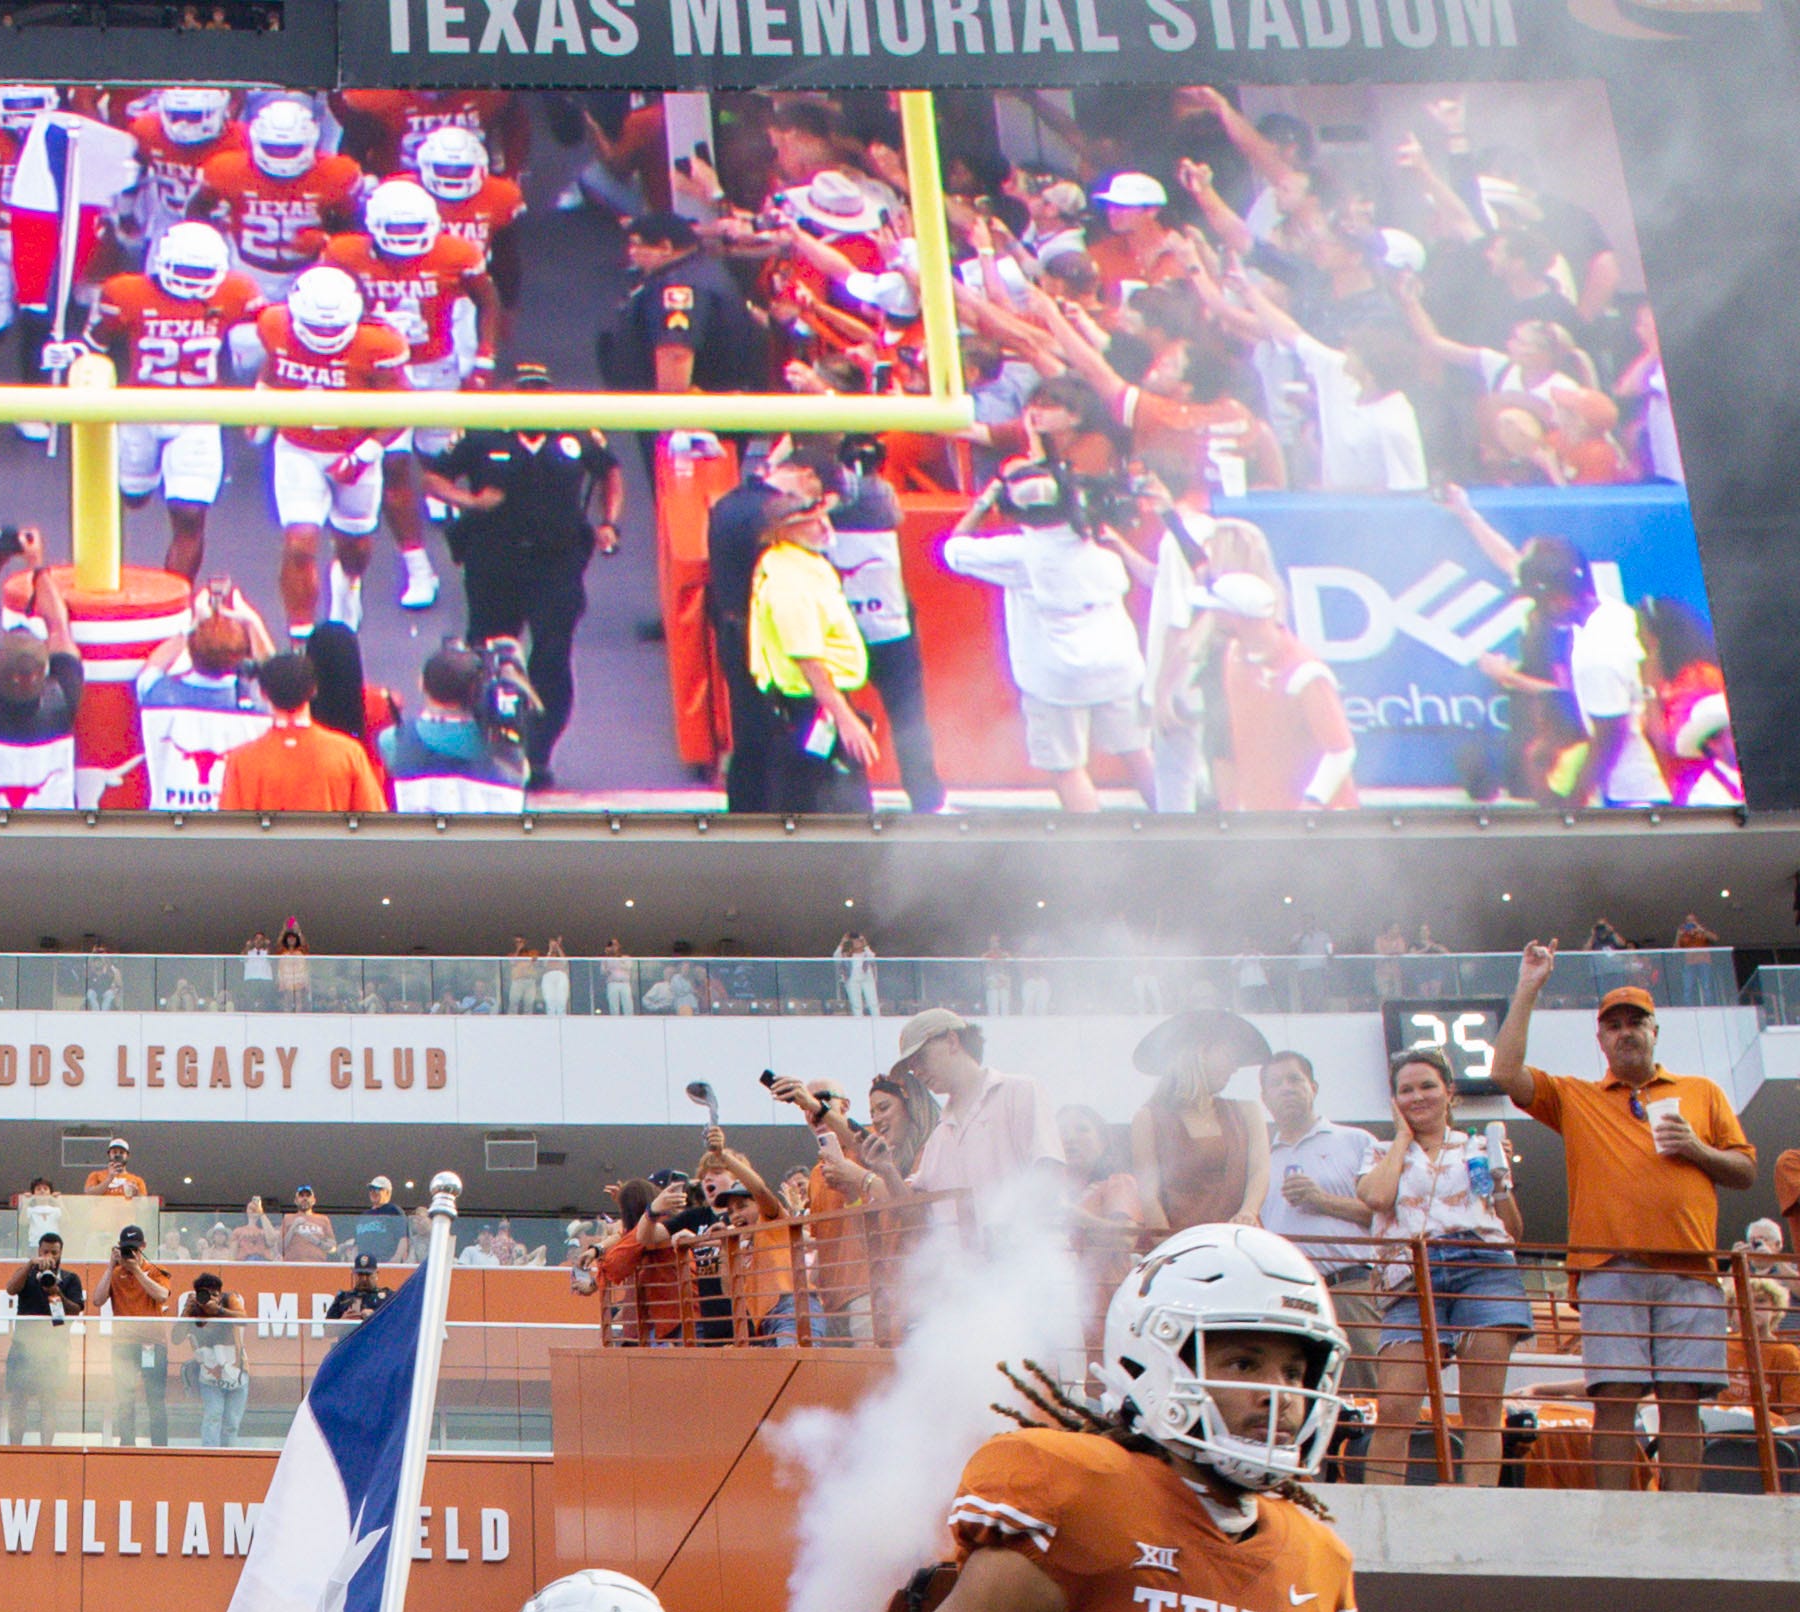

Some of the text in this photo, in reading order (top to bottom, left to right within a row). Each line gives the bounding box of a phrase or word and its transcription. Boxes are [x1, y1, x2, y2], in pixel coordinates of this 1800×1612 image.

[389, 0, 1518, 57] TEXAS MEMORIAL STADIUM
[247, 201, 319, 218] TEXAS
[363, 279, 439, 300] TEXAS
[144, 317, 220, 339] TEXAS
[137, 336, 222, 386] 23
[276, 356, 346, 388] TEXAS
[117, 1045, 298, 1089] LEGACY
[330, 1046, 448, 1090] CLUB
[410, 1505, 510, 1562] ELD
